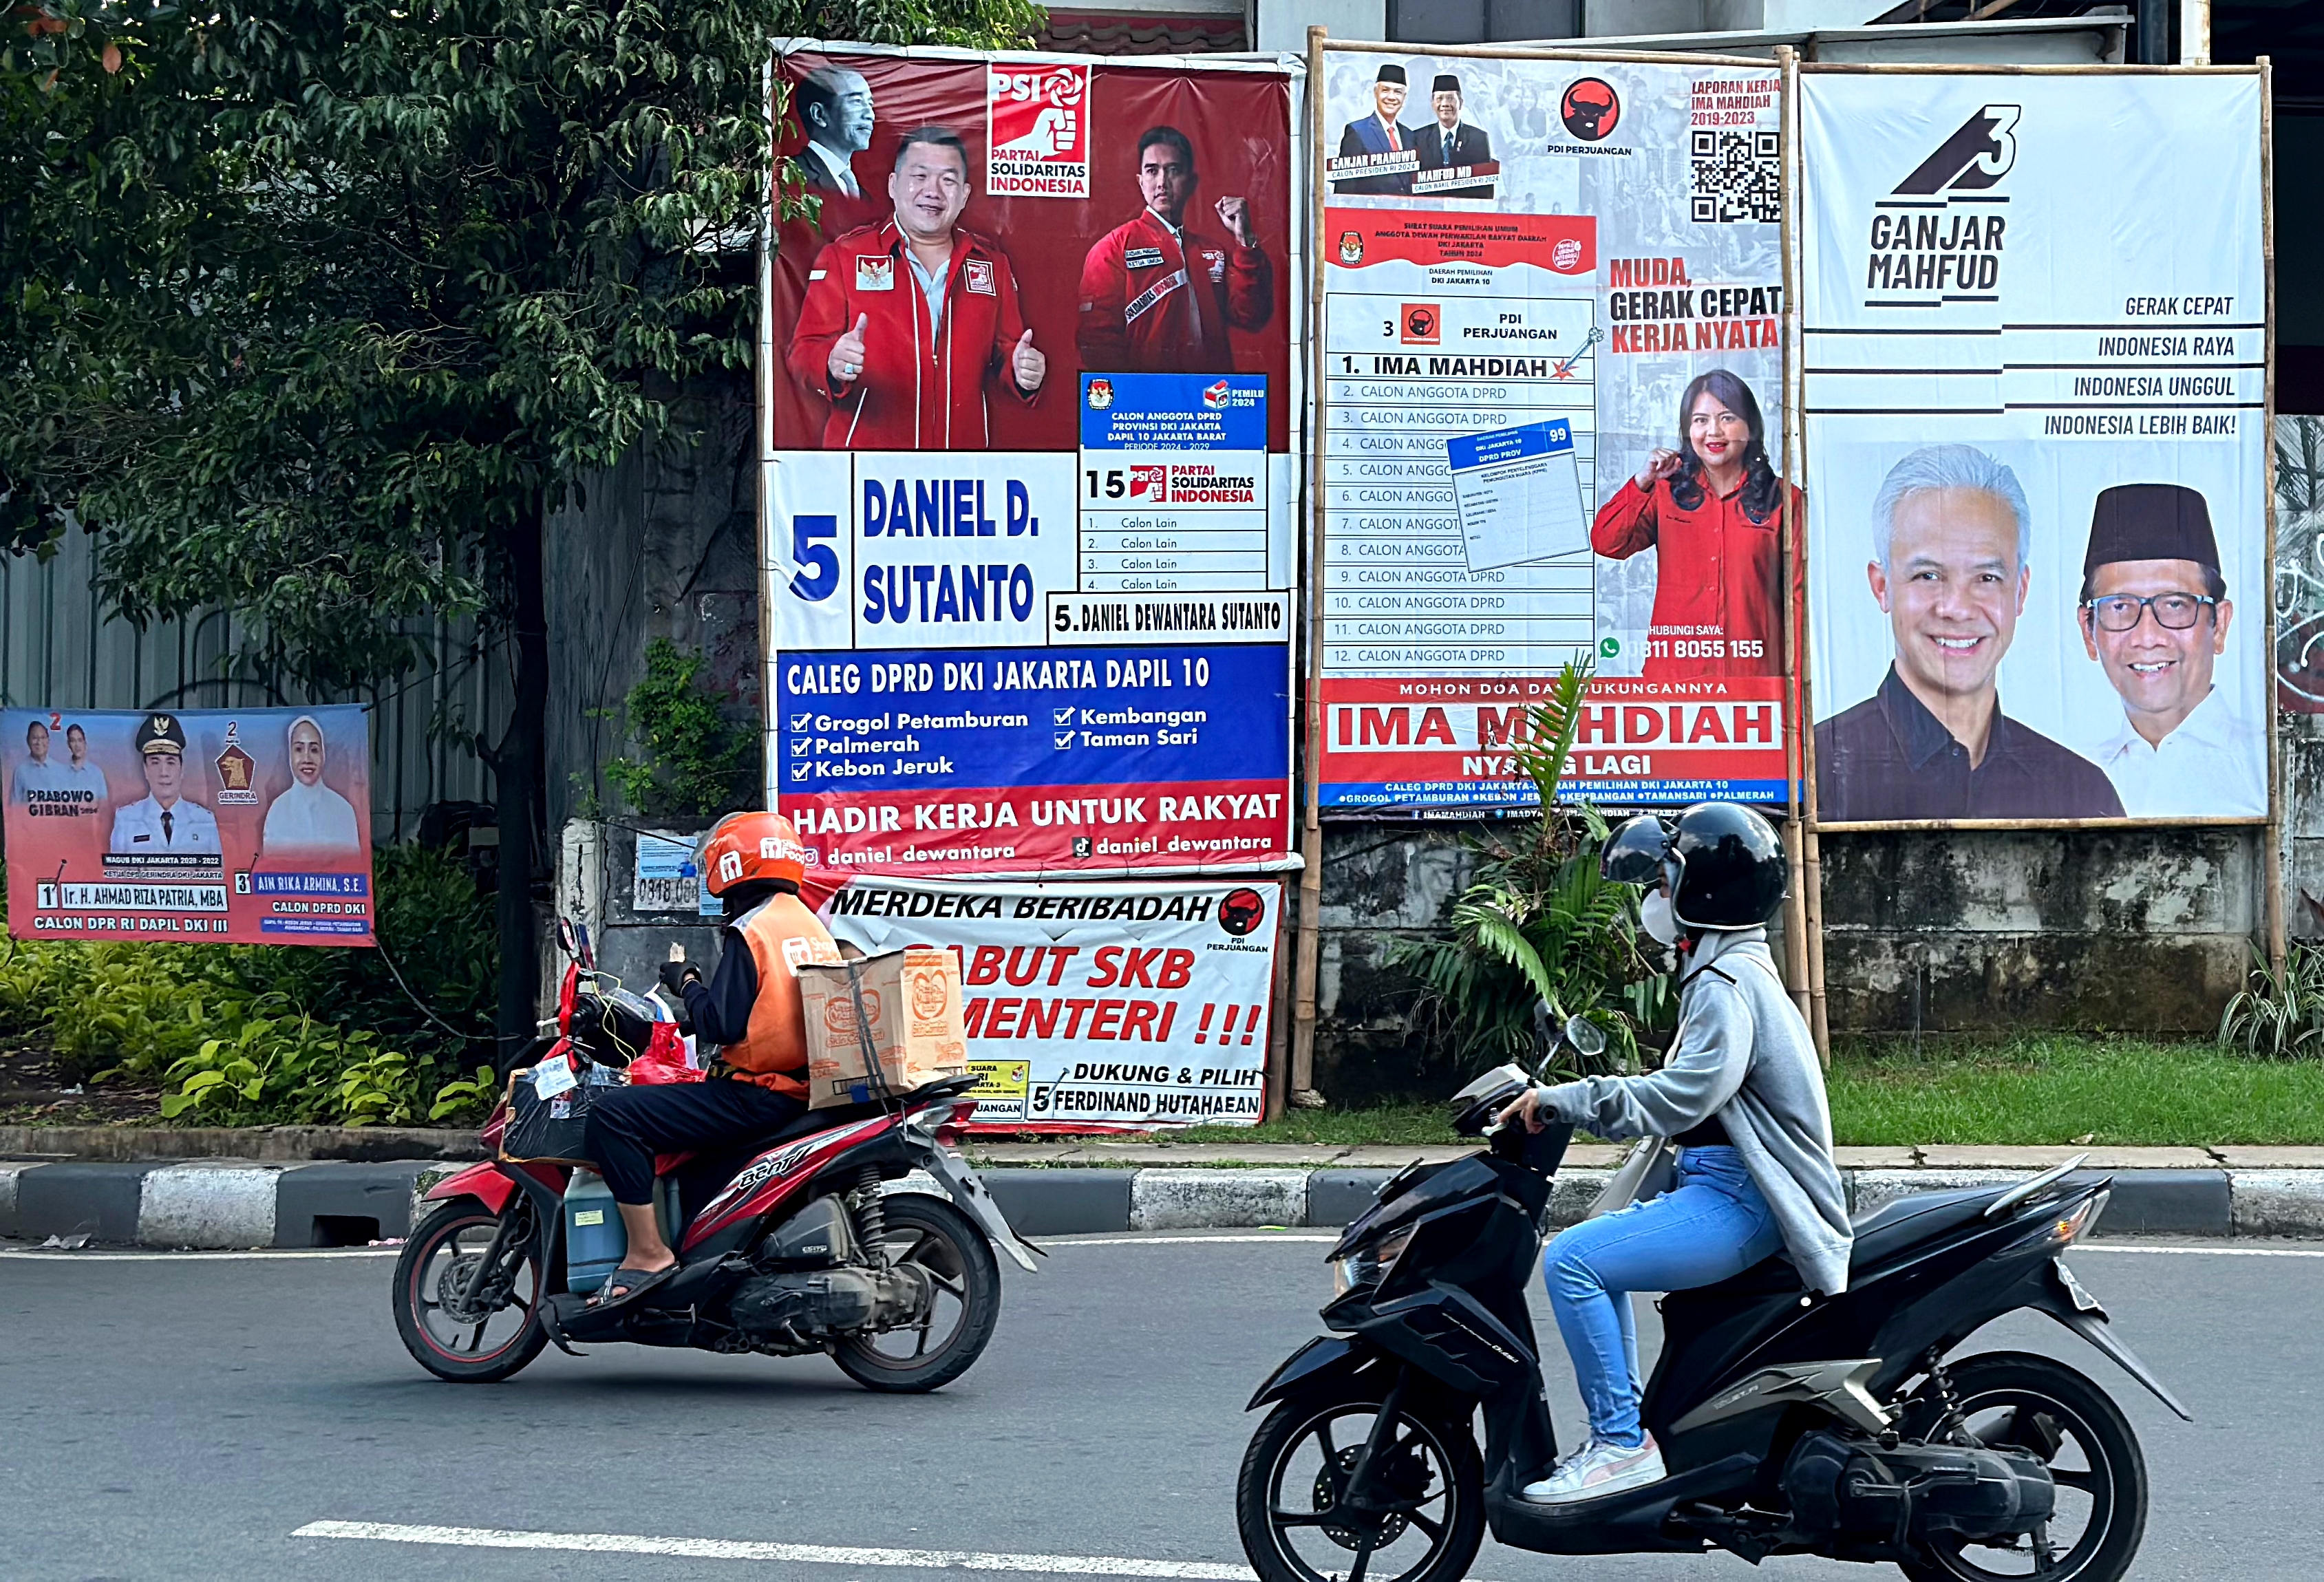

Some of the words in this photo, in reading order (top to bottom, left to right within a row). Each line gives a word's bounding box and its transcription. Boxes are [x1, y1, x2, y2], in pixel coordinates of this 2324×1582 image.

[992, 73, 1041, 102] PSI
[1692, 81, 1744, 94] LAPORAN
[1747, 78, 1780, 92] KERJA
[1692, 96, 1714, 111] IMA
[1716, 95, 1771, 109] MAHDIAH
[1691, 111, 1755, 126] 2019-2023
[991, 149, 1039, 162] PARTAI
[1548, 145, 1564, 153] PDI
[1566, 146, 1632, 156] PERJUANGAN
[1332, 154, 1368, 170] GANJAR
[1370, 149, 1416, 166] PRANOWO
[991, 162, 1085, 178] SOLIDARITAS
[1332, 170, 1353, 178] CALON
[1355, 167, 1388, 175] PRESIDEN
[991, 177, 1085, 193] INDONESIA
[1870, 215, 2006, 251] GANJAR
[1610, 257, 1692, 288] MUDA,
[1867, 253, 1998, 290] MAHFUD
[1610, 290, 1694, 321] GERAK
[1701, 286, 1782, 317] CEPAT
[2125, 297, 2179, 316] GERAK
[2183, 297, 2234, 316] CEPAT
[1500, 313, 1522, 324] PDI
[1383, 320, 1394, 337] 3
[1463, 328, 1557, 340] PERJUANGAN
[1612, 323, 1689, 353] KERJA
[1696, 319, 1779, 350] NYATA
[2098, 336, 2188, 356] INDONESIA
[2193, 336, 2235, 356] RAYA
[1342, 356, 1360, 374] 1.
[1374, 356, 1421, 376] IMA
[1429, 357, 1547, 378] MAHDIAH
[1232, 389, 1264, 398] PEMILU
[1361, 386, 1403, 398] CALON
[1407, 387, 1469, 398] ANGGOTA
[1473, 387, 1506, 399] DPRD
[2074, 376, 2164, 396] INDONESIA
[2168, 376, 2235, 396] UNGGUL
[1232, 398, 1255, 407] 2024
[1111, 412, 1144, 420] CALON
[1361, 412, 1403, 424] CALON
[1407, 413, 1469, 425] ANGGOTA
[1472, 413, 1507, 425] DPRD
[1112, 423, 1158, 431] PROVINSI
[1160, 423, 1178, 431] DKI
[2045, 416, 2133, 436] INDONESIA
[2138, 416, 2187, 436] LEBIH
[2193, 416, 2236, 436] BAIK!
[1107, 433, 1135, 441] DAPIL
[1138, 433, 1150, 441] 10
[1152, 433, 1194, 441] JAKARTA
[1196, 433, 1226, 441] BARAT
[1549, 427, 1566, 442] 99
[1360, 438, 1403, 450] CALON
[1171, 465, 1215, 475] PARTAI
[1360, 464, 1403, 475] CALON
[1087, 470, 1126, 498] 15
[1171, 477, 1254, 489] SOLIDARITAS
[1171, 490, 1254, 502] INDONESIA
[864, 479, 996, 537] DANIEL
[1007, 480, 1039, 537] D.
[1121, 517, 1152, 528] Calon
[1156, 517, 1177, 528] Lain
[1121, 538, 1152, 549] Calon
[1156, 538, 1177, 549] Lain
[789, 515, 840, 602] 5
[1121, 559, 1152, 570] Calon
[1156, 559, 1177, 570] Lain
[1121, 579, 1152, 590] Calon
[1156, 579, 1177, 590] Lain
[863, 563, 1034, 624] SUTANTO
[1358, 597, 1401, 609] CALON
[1405, 597, 1467, 609] ANGGOTA
[1471, 597, 1505, 608] DPRD
[1054, 605, 1078, 632] 5.
[1082, 603, 1129, 632] DANIEL
[1136, 603, 1216, 631] DEWANTARA
[1222, 602, 1281, 630] SUTANTO
[1649, 625, 1694, 635] HUBUNGI
[1358, 650, 1401, 661] CALON
[1405, 650, 1467, 661] ANGGOTA
[1471, 650, 1505, 661] DPRD
[1674, 640, 1725, 658] 8055
[1729, 640, 1764, 658] 155
[787, 663, 860, 694] CALEG
[871, 662, 933, 693] DPRD
[944, 661, 983, 692] DKI
[993, 660, 1097, 691] JAKARTA
[1106, 659, 1172, 688] DAPIL
[1183, 658, 1209, 687] 10
[1400, 683, 1471, 695] MOHON
[1480, 683, 1520, 695] DOA
[815, 713, 889, 735] Grogol
[897, 711, 1028, 729] Petamburan
[1080, 707, 1206, 727] Kembangan
[1339, 707, 1457, 746] IMA
[815, 735, 919, 754] Palmerah
[1081, 731, 1149, 747] Taman
[1157, 729, 1198, 745] Sari
[815, 759, 885, 777] Kebon
[893, 756, 954, 775] Jeruk
[1586, 755, 1651, 775] LAGI
[1579, 781, 1638, 790] PEMILIHAN
[1641, 781, 1661, 789] DKI
[1663, 780, 1713, 789] JAKARTA
[1346, 794, 1392, 803] GROGOL
[1394, 793, 1469, 802] PETAMBURAN
[1645, 791, 1707, 800] TAMANSARI
[1716, 791, 1774, 800] PALMERAH
[29, 804, 79, 817] GIBRAN
[793, 806, 902, 835] HADIR
[915, 802, 1019, 831] KERJA
[1032, 798, 1147, 826] UNTUK
[1159, 793, 1281, 822] RAKYAT
[1097, 836, 1272, 855] daniel_dewantara
[827, 845, 1015, 865] daniel_dewantara
[259, 876, 276, 890] AIN
[278, 876, 300, 891] RIKA
[94, 888, 131, 905] AHMAD
[134, 888, 157, 906] RIZA
[200, 890, 224, 907] MBA
[829, 889, 1002, 919] MERDEKA
[1013, 896, 1213, 922] BERIBADAH
[273, 902, 309, 912] CALON
[34, 917, 83, 930] CALON
[87, 917, 116, 930] DPR
[120, 918, 135, 930] RI
[139, 918, 180, 931] DAPIL
[184, 919, 209, 932] DKI
[1207, 943, 1268, 952] PERJUANGAN
[1087, 946, 1195, 989] SKB
[964, 997, 1178, 1042] MENTERI
[1074, 1063, 1169, 1083] DUKUNG
[1177, 1067, 1192, 1084] &
[1200, 1069, 1257, 1086] PILIH
[1054, 1091, 1150, 1113] FERDINAND
[1156, 1093, 1259, 1115] HUTAHAEAN
